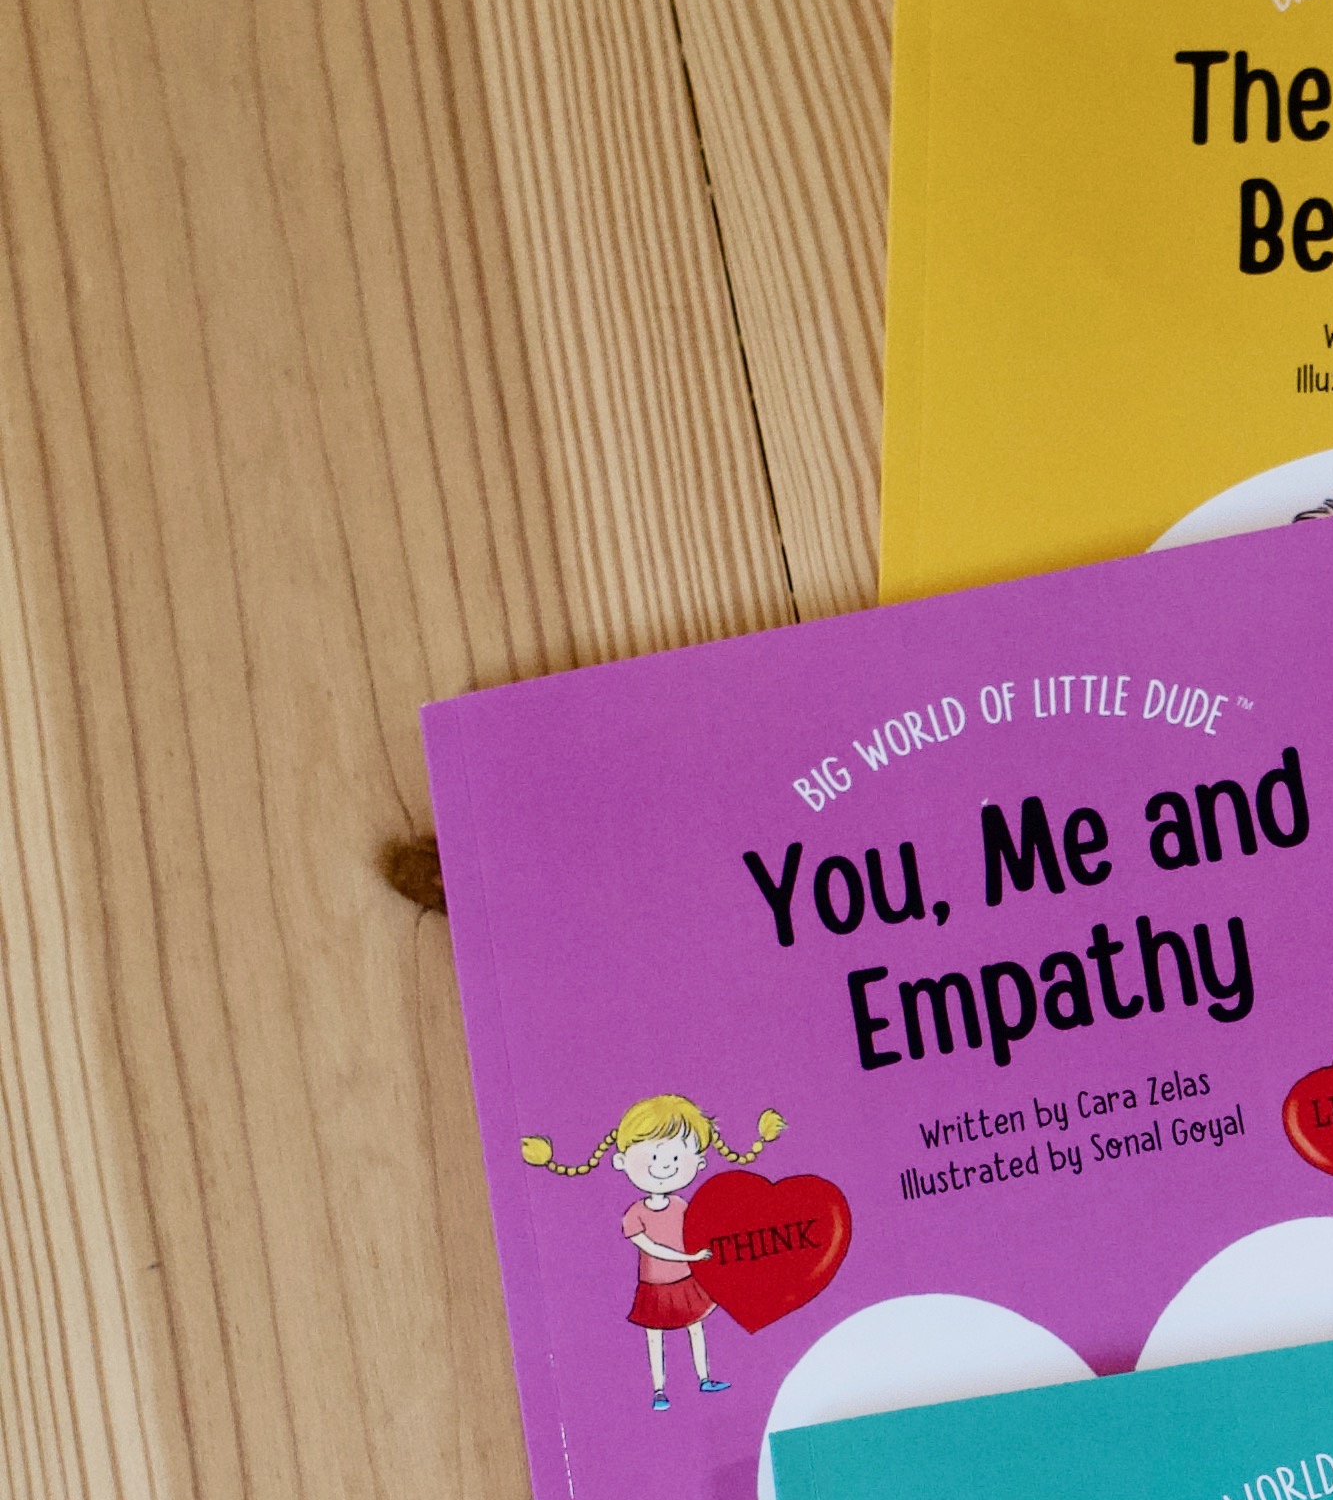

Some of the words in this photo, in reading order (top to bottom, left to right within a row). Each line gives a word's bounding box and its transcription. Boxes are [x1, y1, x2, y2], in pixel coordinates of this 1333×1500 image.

[1175, 51, 1331, 145] The
[793, 757, 851, 812] BIG
[853, 697, 965, 771] WORLD
[980, 682, 1014, 724] OF
[1034, 675, 1130, 717] LITTLE
[743, 842, 950, 947] You,
[981, 796, 1112, 907] Me
[1145, 747, 1309, 870] and
[848, 916, 1254, 1070] Empathy
[901, 1146, 1039, 1200] Illustrated
[1047, 1141, 1082, 1175] by
[1091, 1121, 1162, 1161] Sonal
[1172, 1104, 1244, 1147] Goyal
[919, 1109, 1025, 1149] Written
[1033, 1098, 1068, 1131] by
[1078, 1090, 1137, 1118] Cara
[1147, 1071, 1210, 1105] Zelas
[708, 1219, 820, 1261] THINK
